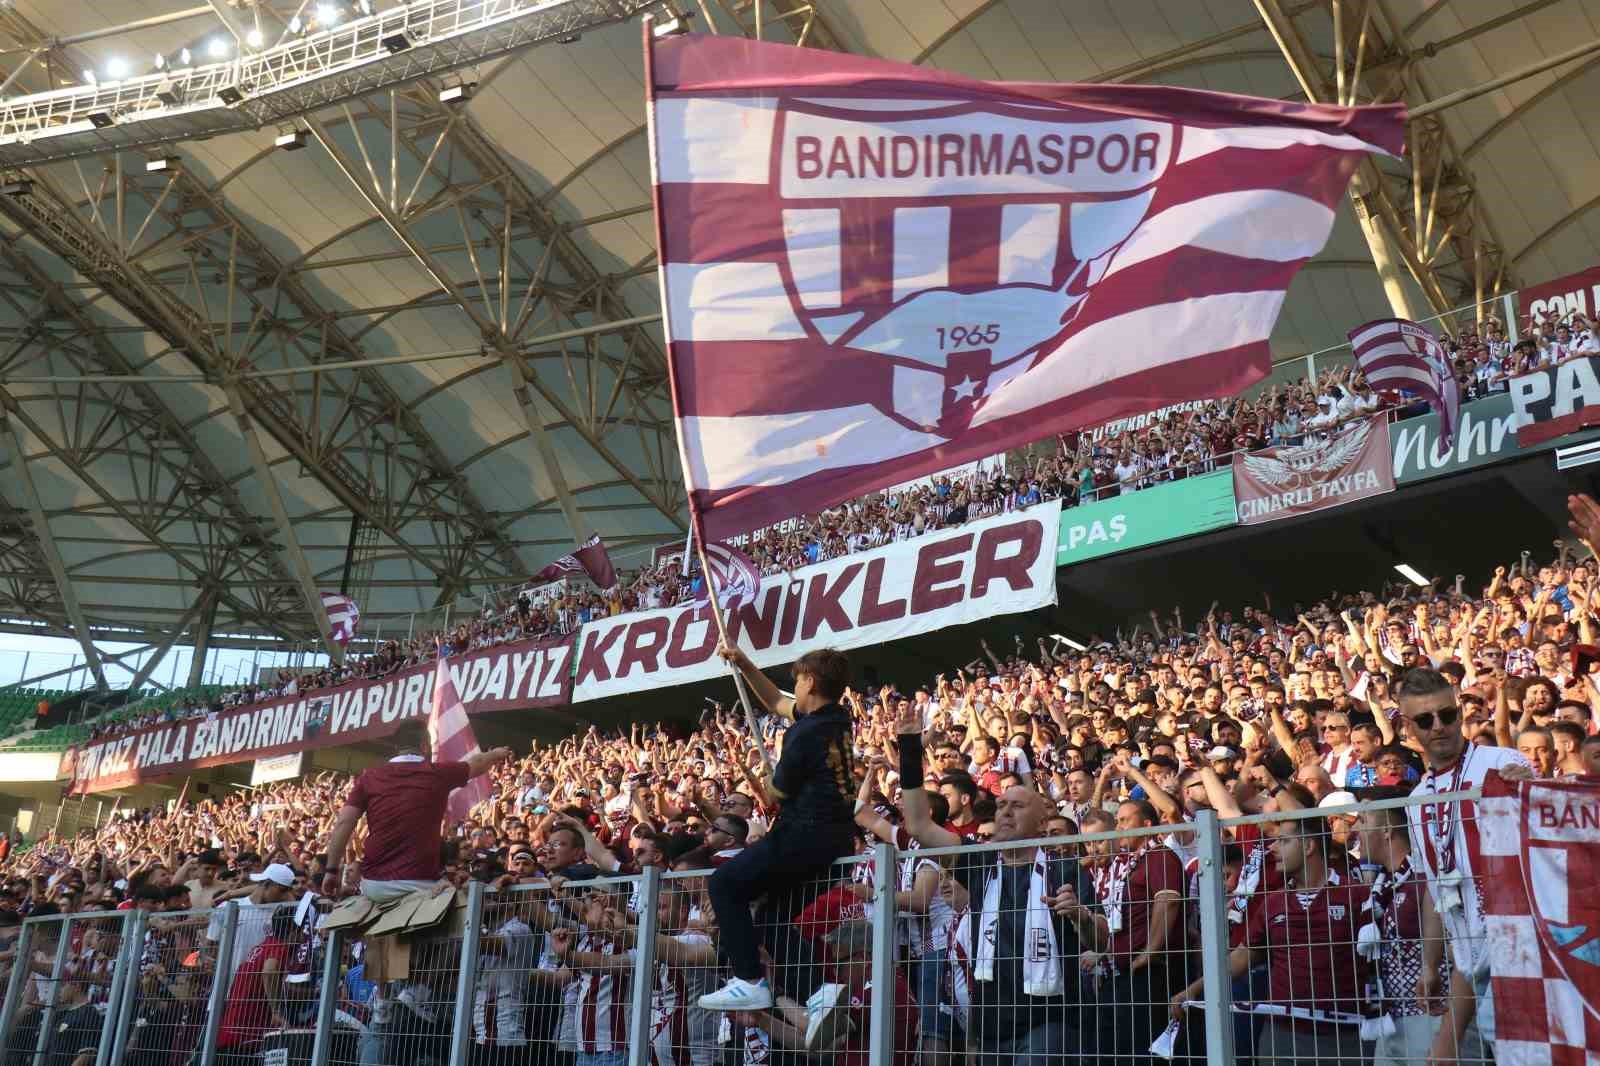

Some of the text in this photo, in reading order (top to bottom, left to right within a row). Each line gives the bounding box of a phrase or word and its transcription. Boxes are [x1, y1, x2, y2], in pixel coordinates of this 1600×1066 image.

[796, 131, 1161, 179] BANDIRMASPOR
[936, 323, 1001, 350] 1965
[1319, 469, 1379, 499] TAYFA
[132, 725, 188, 770] HALA
[188, 700, 306, 760] BANDIRMA
